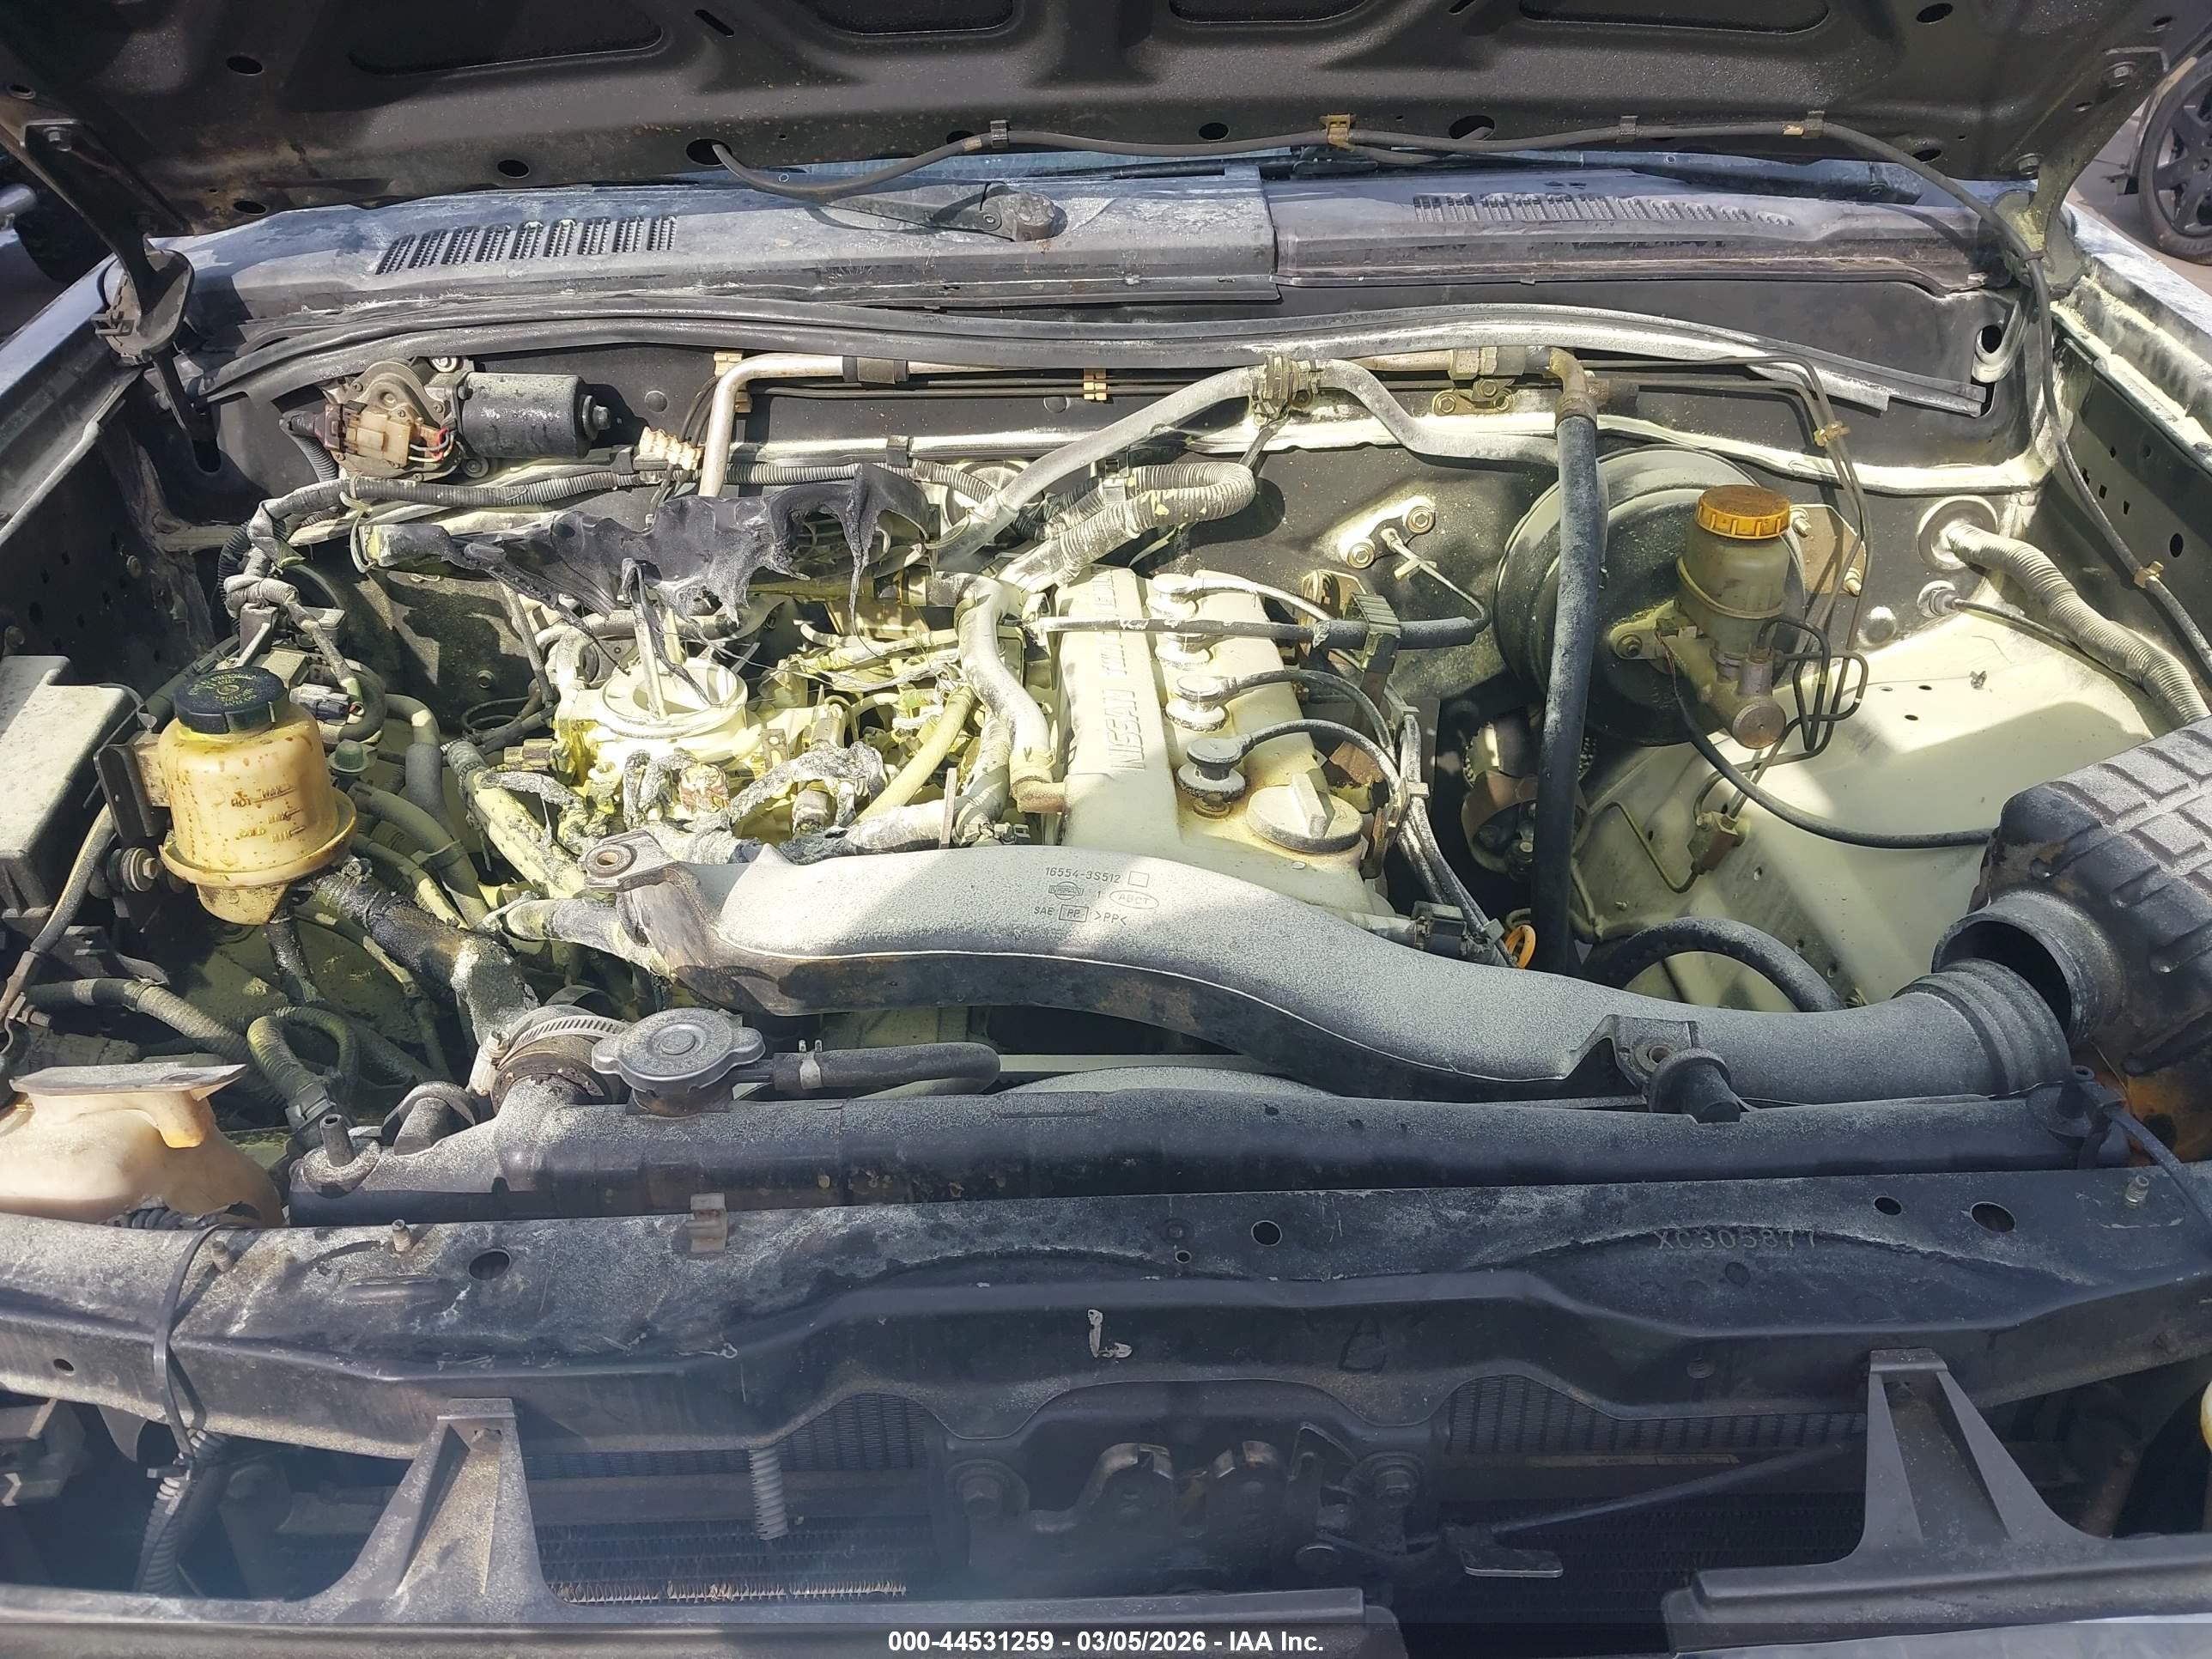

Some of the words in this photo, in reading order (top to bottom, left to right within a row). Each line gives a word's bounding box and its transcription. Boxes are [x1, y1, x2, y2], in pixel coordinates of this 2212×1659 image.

[1103, 690, 1146, 769] NISSAN
[1045, 867, 1121, 884] 16554-3S512
[1034, 906, 1054, 916] SAE
[1067, 909, 1080, 918] PP
